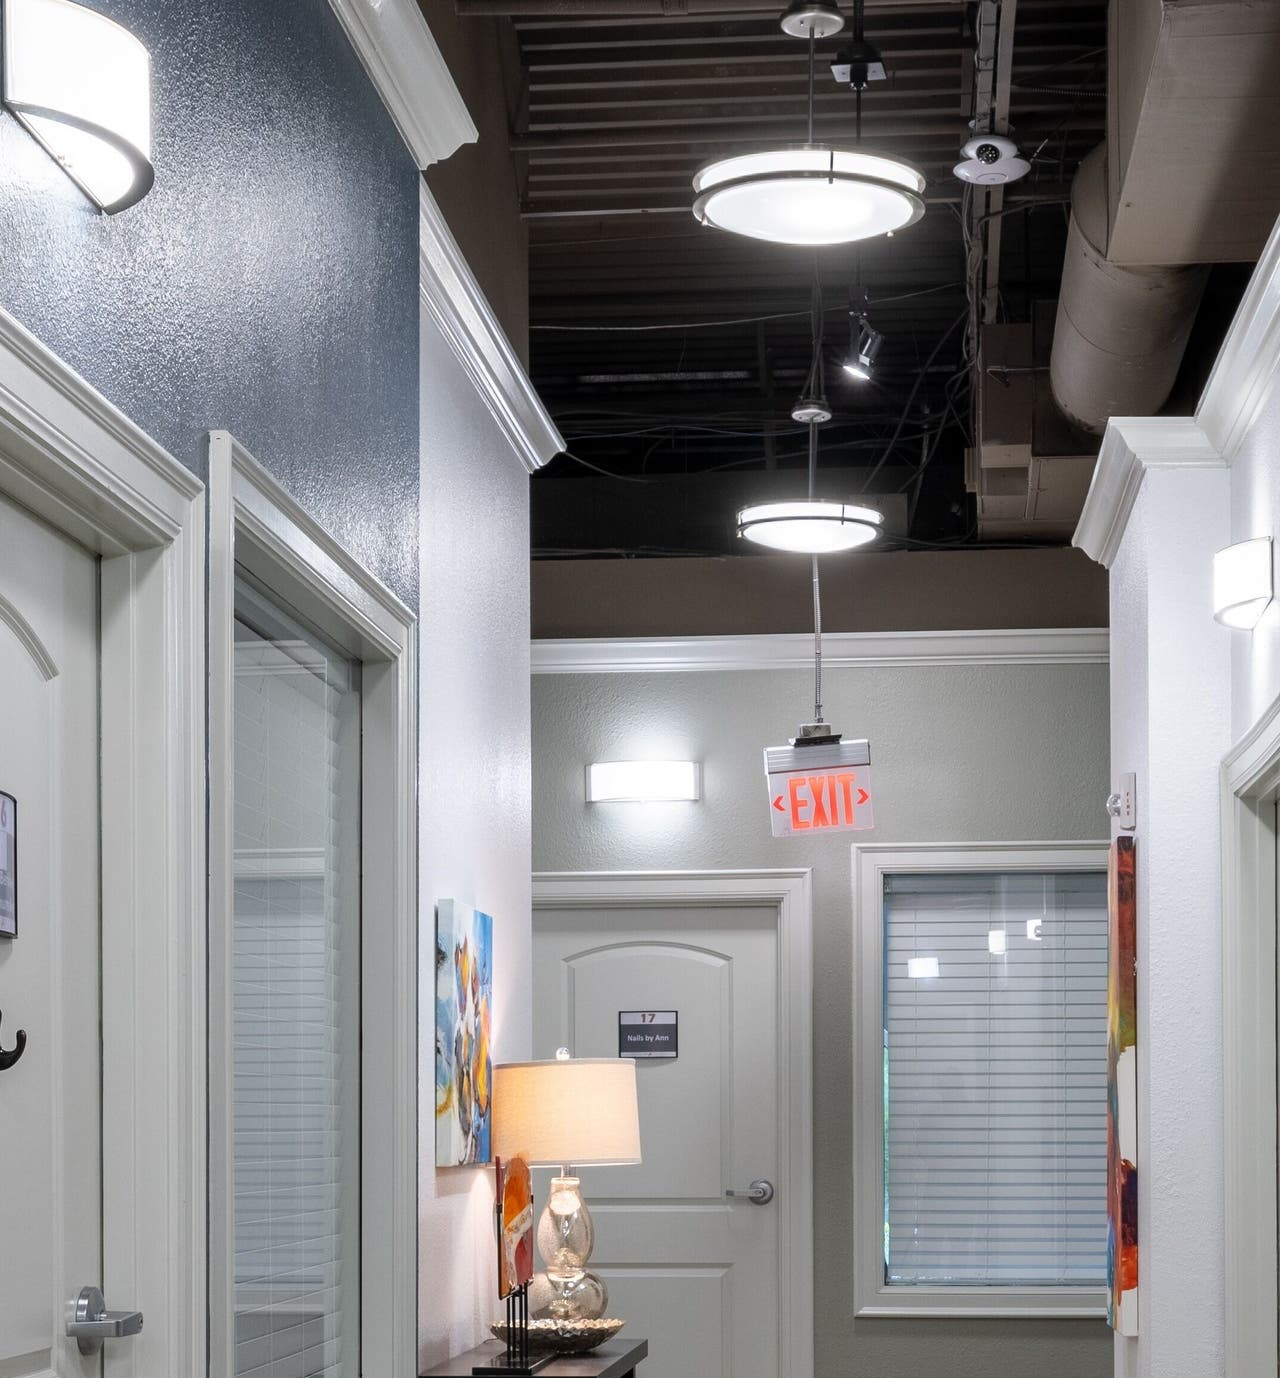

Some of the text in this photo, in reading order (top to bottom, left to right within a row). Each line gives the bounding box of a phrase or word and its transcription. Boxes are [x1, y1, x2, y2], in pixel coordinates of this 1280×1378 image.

[788, 772, 856, 831] EXIT
[641, 1013, 656, 1023] 17
[627, 1034, 669, 1043] Nails by Ann
